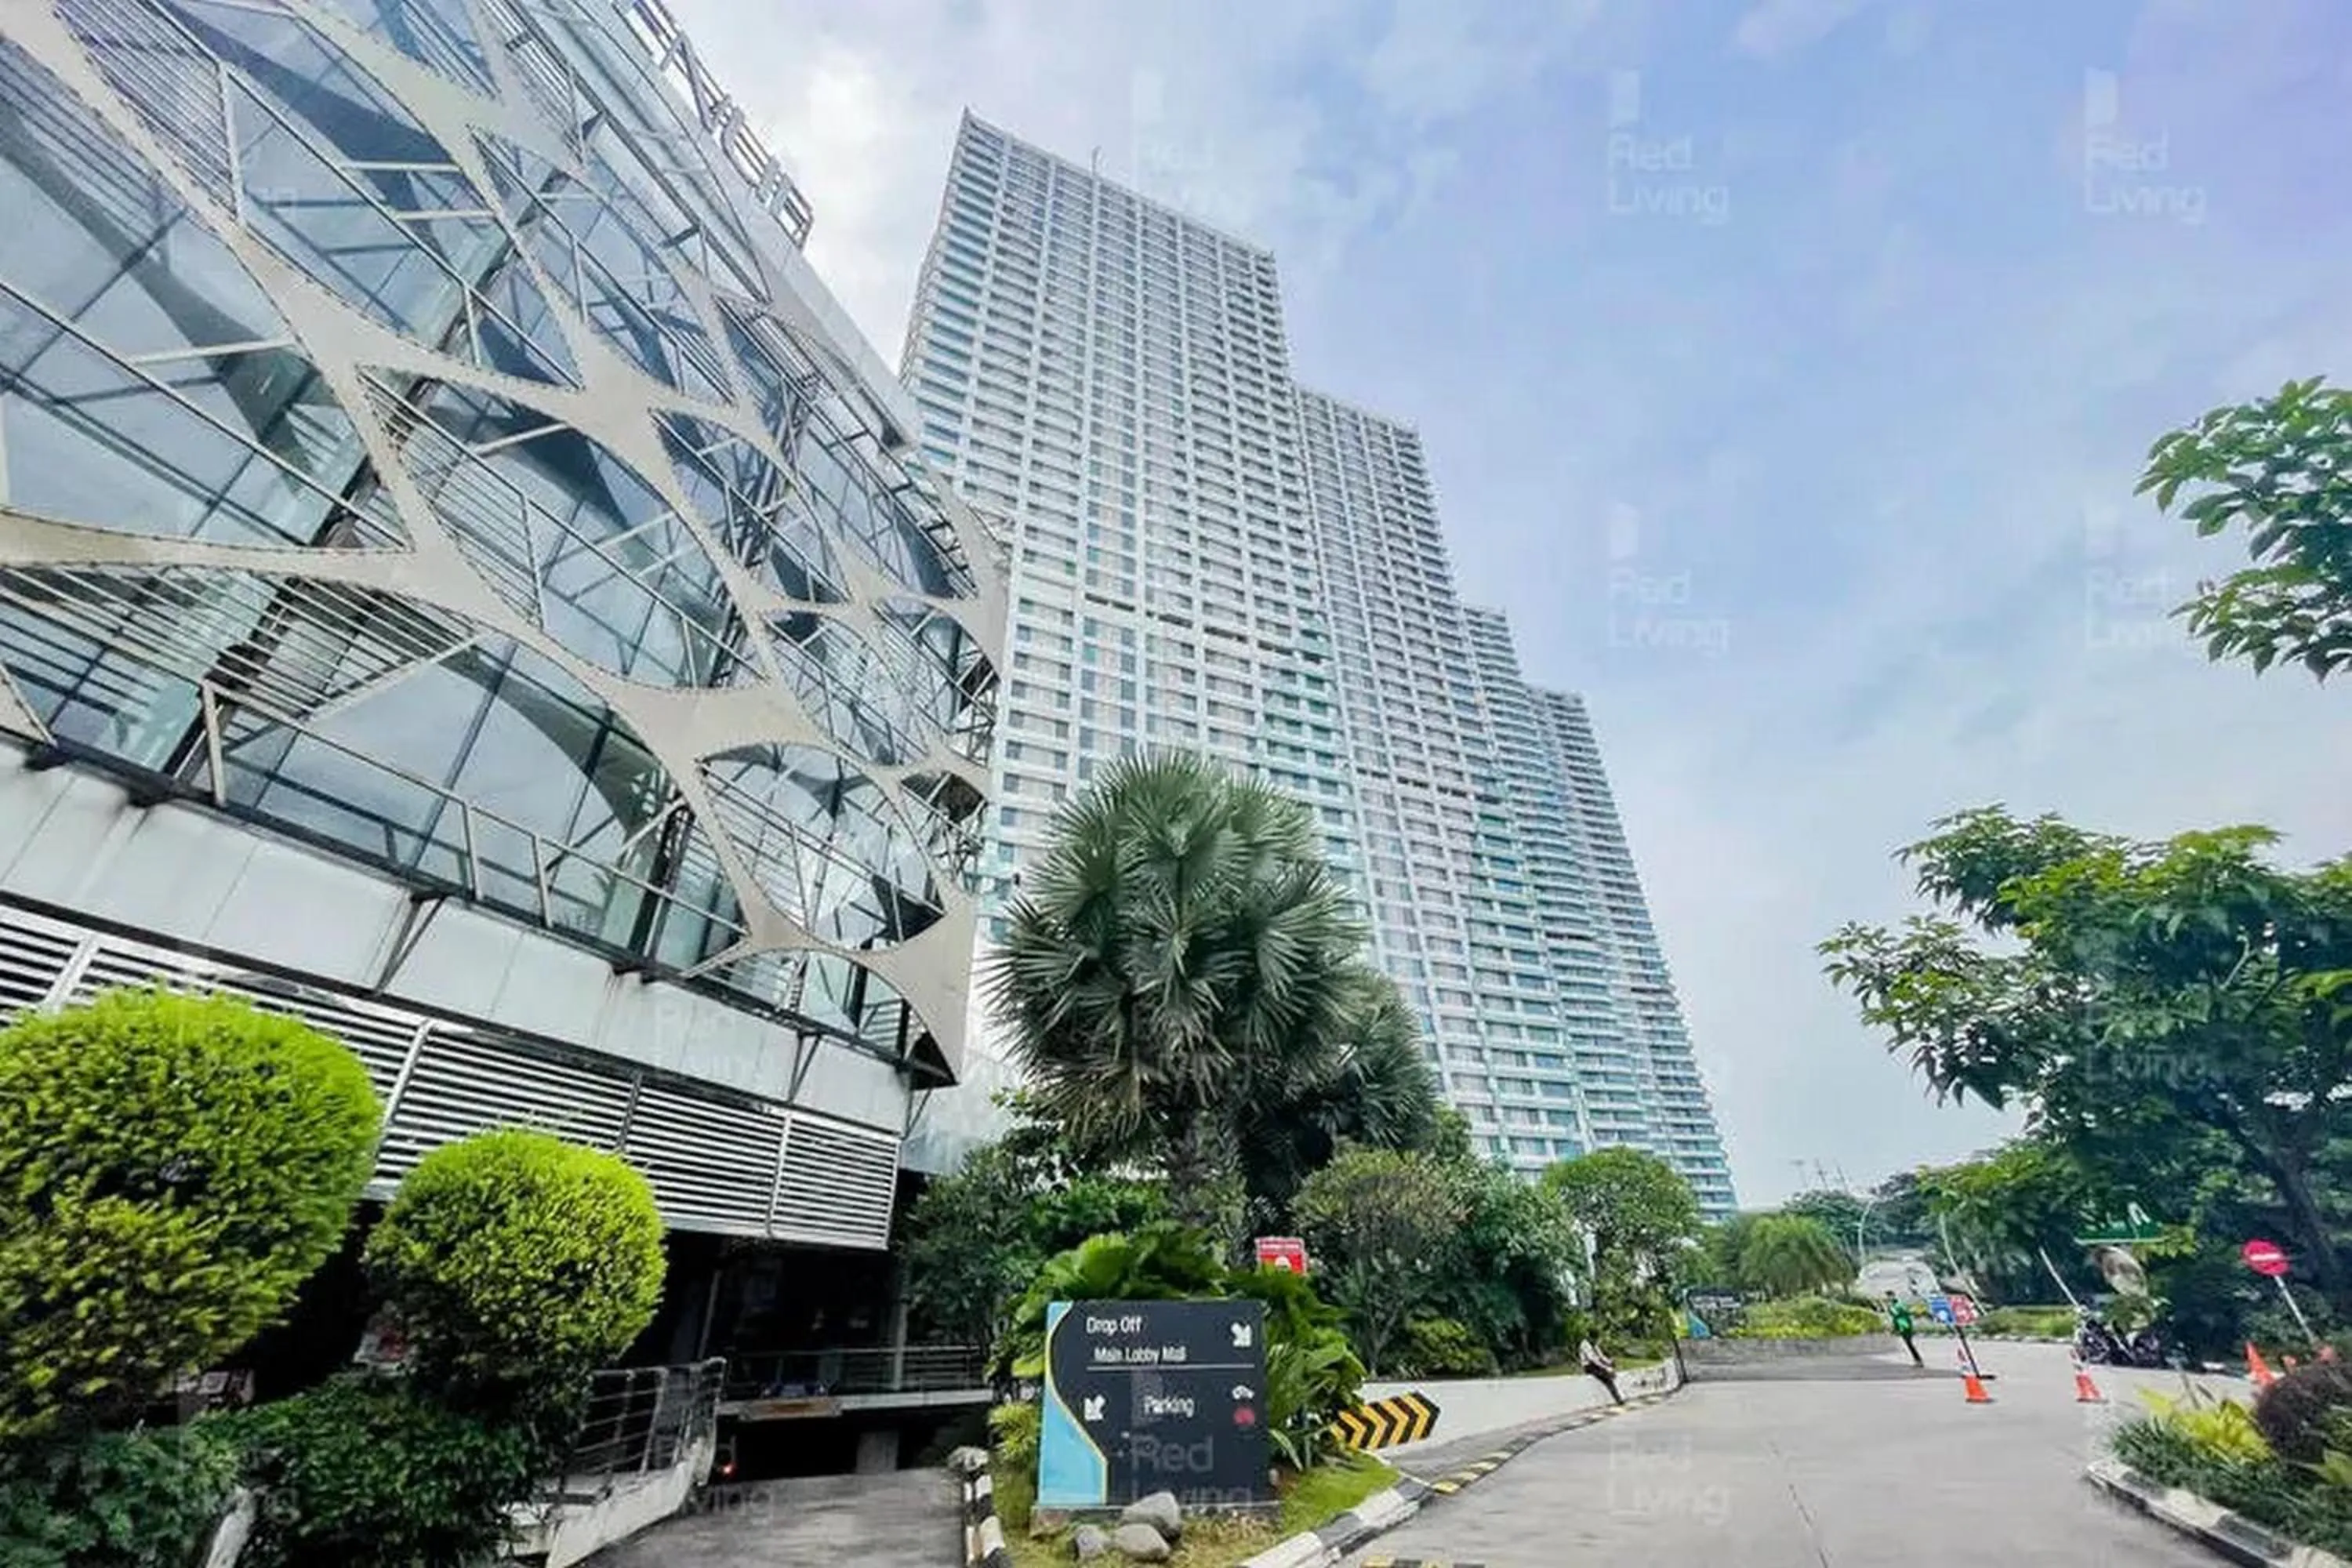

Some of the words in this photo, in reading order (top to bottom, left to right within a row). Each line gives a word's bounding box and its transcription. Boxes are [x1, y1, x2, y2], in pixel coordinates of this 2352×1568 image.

[1086, 1316, 1118, 1337] Drop
[1120, 1316, 1142, 1333] Off
[1094, 1346, 1123, 1363] Main
[1125, 1346, 1160, 1364] Lobby
[1162, 1345, 1186, 1362] Mall
[1143, 1395, 1195, 1418] Parking
